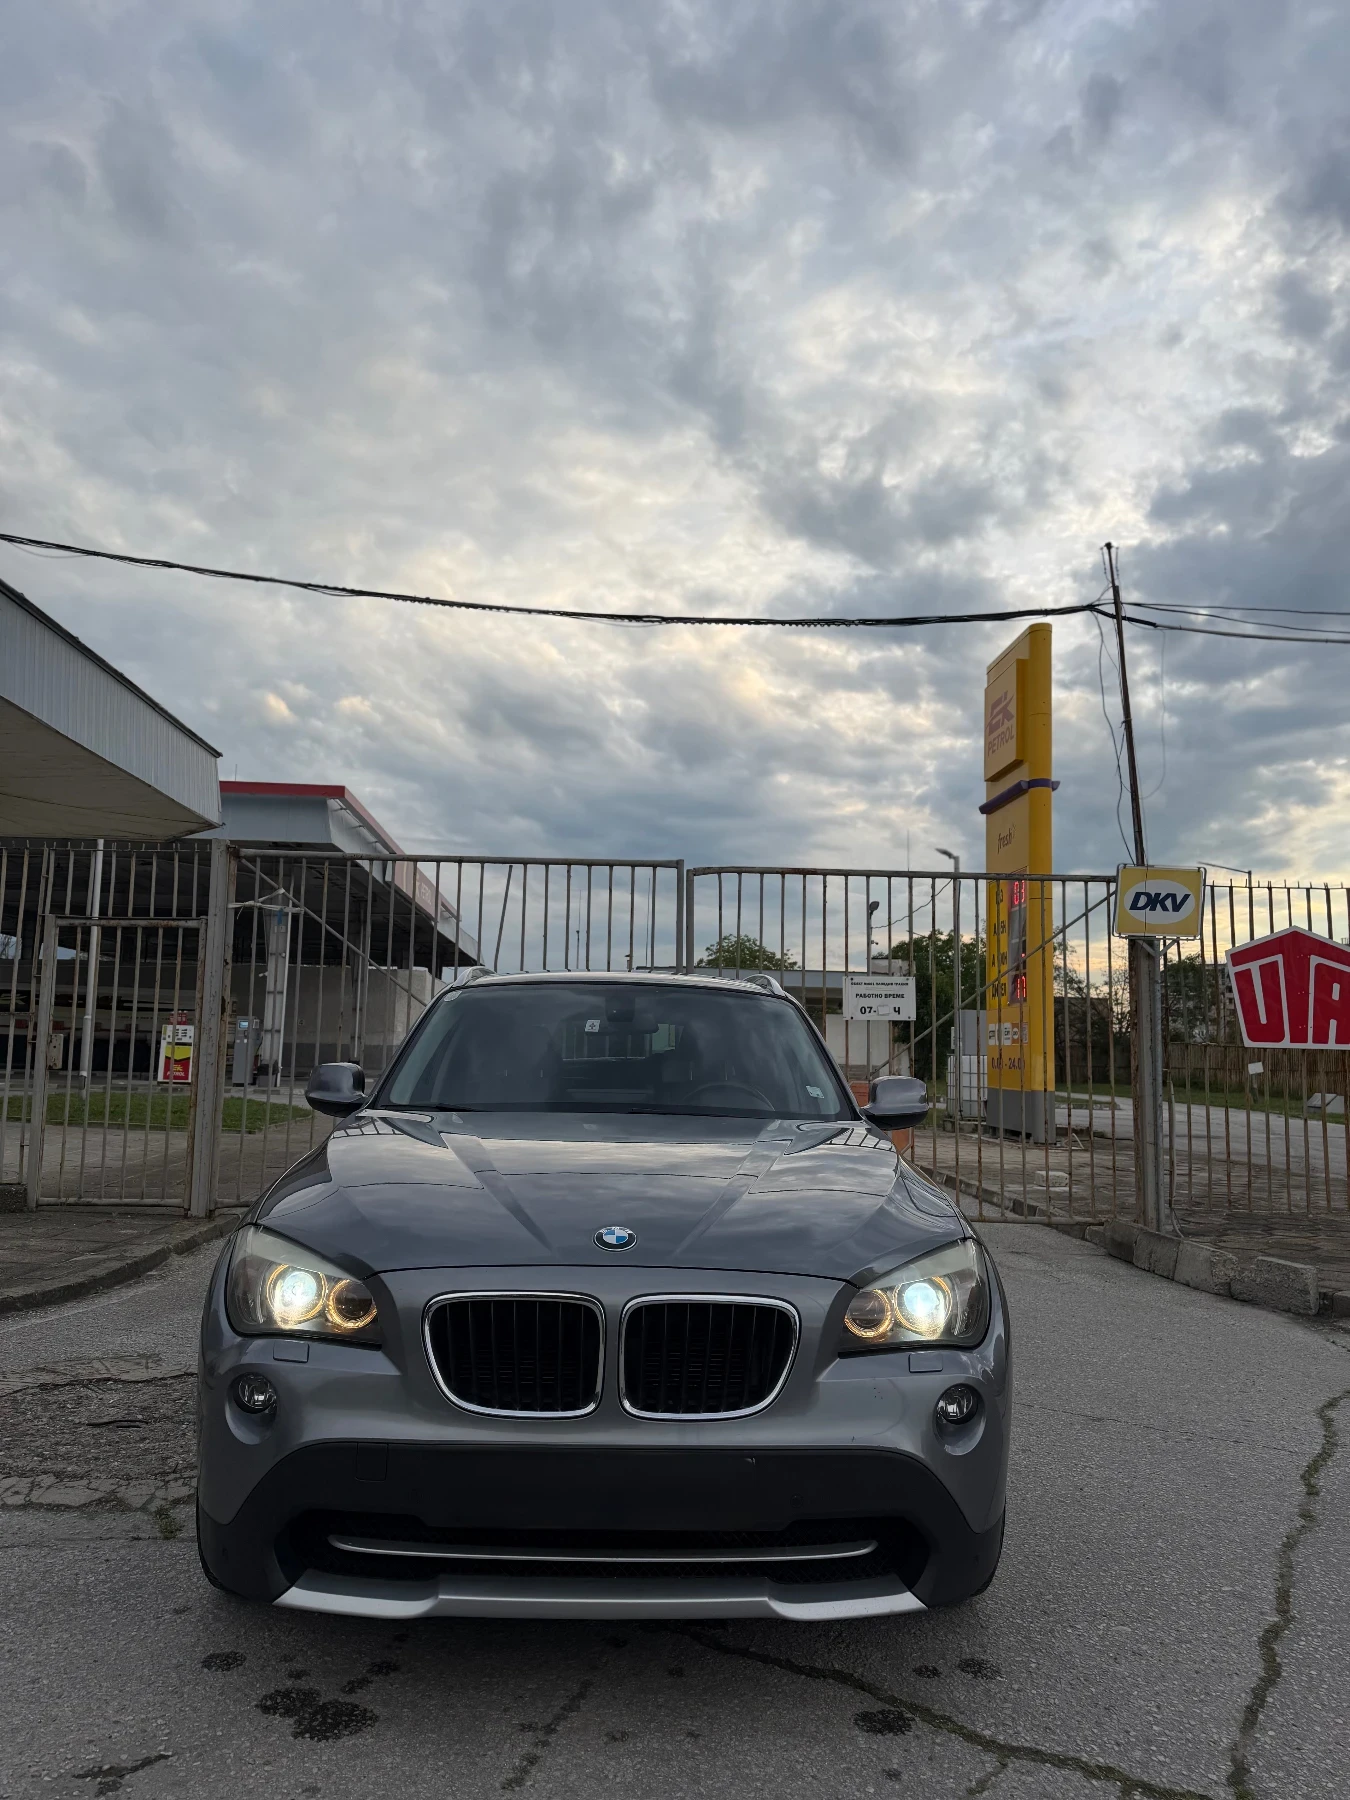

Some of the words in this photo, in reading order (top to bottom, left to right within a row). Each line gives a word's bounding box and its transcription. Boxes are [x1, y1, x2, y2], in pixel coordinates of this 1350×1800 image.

[987, 724, 1015, 756] PETROL
[997, 827, 1013, 854] fresh
[1129, 891, 1191, 913] DKV
